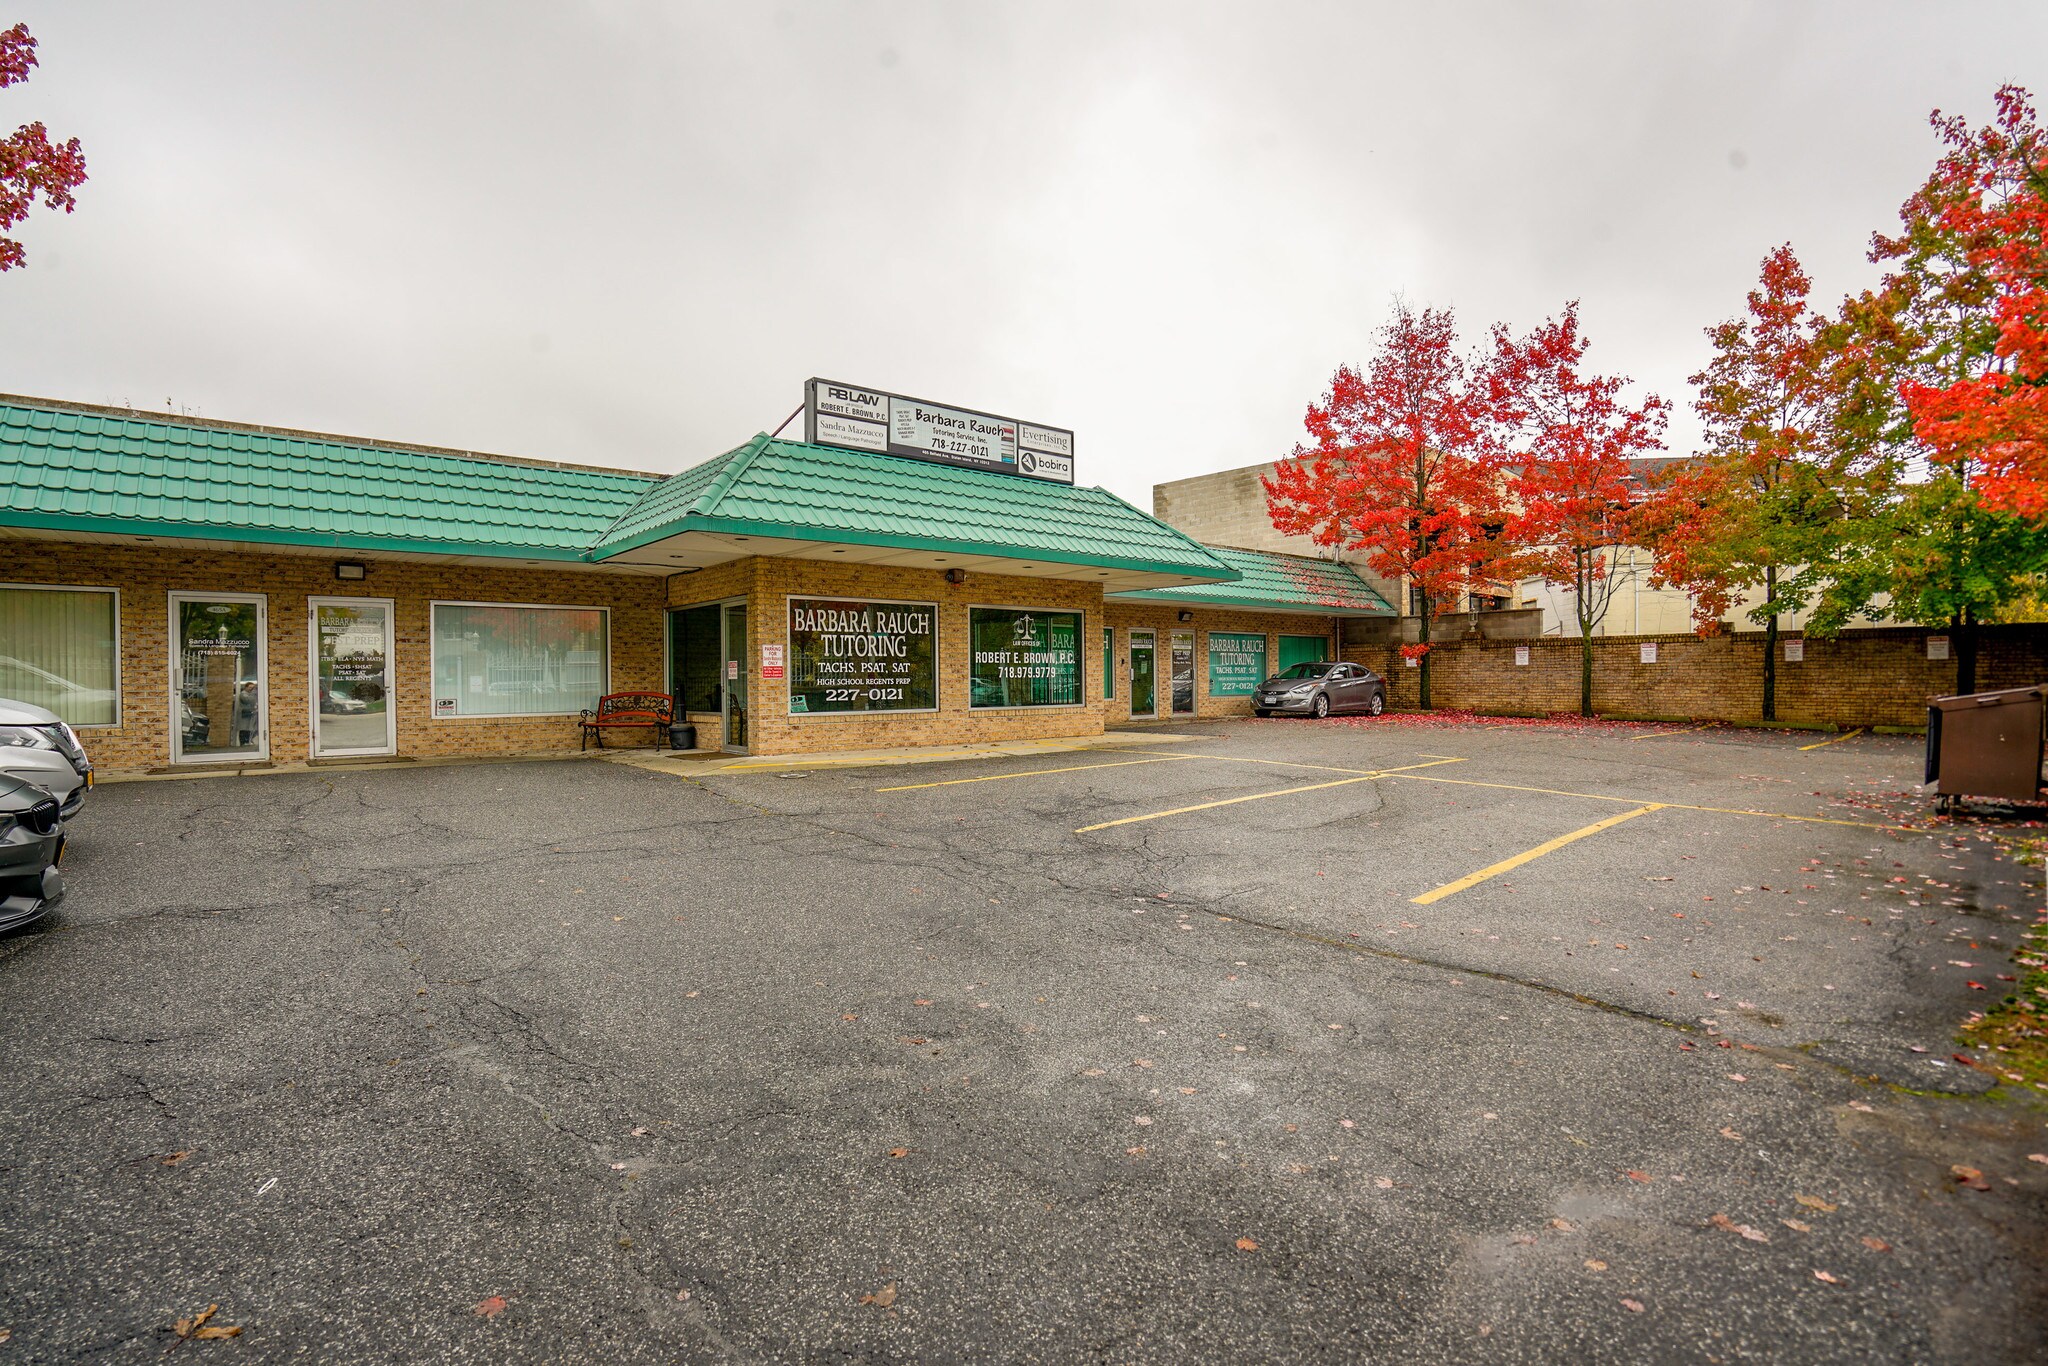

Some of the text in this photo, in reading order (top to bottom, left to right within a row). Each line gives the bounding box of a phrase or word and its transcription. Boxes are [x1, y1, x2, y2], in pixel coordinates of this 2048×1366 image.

[829, 387, 848, 400] RB
[850, 391, 879, 406] LAW
[821, 402, 844, 412] ROBERT
[852, 408, 875, 419] BROWN,
[876, 412, 887, 421] P.C.
[915, 408, 1004, 436] Barbara Rauch
[820, 420, 883, 438] Sandra Mazzucco
[933, 427, 955, 439] Tutoring
[1022, 427, 1067, 450] Evertising
[931, 438, 988, 457] 718-227-0121
[1039, 457, 1068, 471] bobira
[320, 617, 354, 626] BARBARA
[794, 608, 929, 634] BARBARA RAUCH
[324, 636, 380, 644] TEST PREP
[821, 634, 906, 657] TUTORING
[1210, 639, 1264, 652] BARBARA RAUCH
[975, 652, 1011, 664] ROBERT
[1014, 652, 1021, 664] E.
[1024, 652, 1058, 665] BROWN,
[1060, 653, 1075, 664] P.C.
[1220, 652, 1254, 665] TUTORING
[818, 662, 910, 673] TACHS, PSAT, SAT
[998, 667, 1056, 678] 718.979.9779
[826, 689, 903, 702] 227-0121
